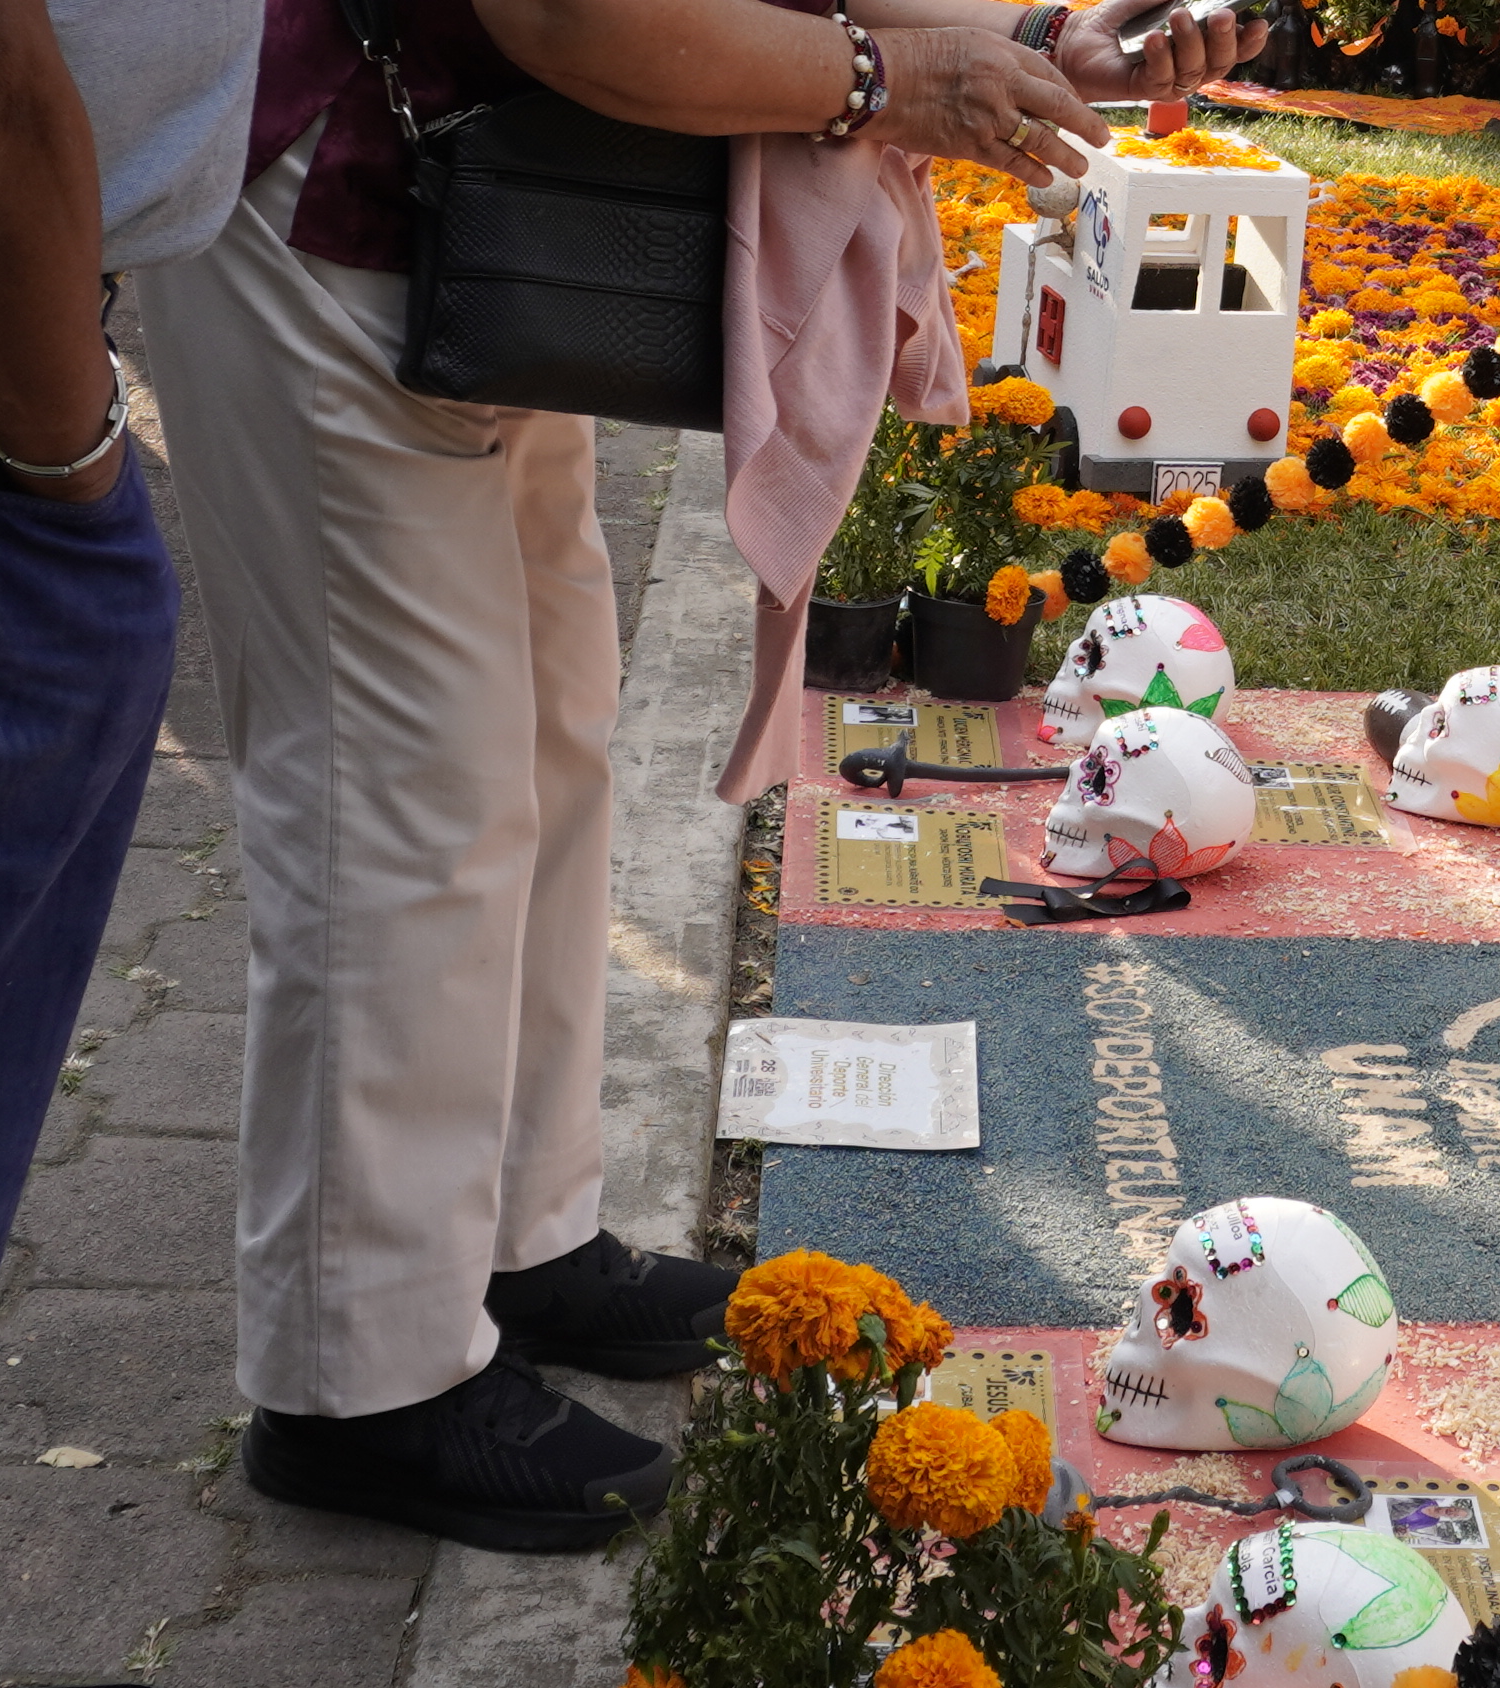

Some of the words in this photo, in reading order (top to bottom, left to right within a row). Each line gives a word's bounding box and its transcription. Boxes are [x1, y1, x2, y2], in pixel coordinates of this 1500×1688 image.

[1086, 264, 1109, 292] SALUD
[1160, 470, 1219, 501] 2025
[954, 822, 973, 864] NOBUYOSHI
[958, 865, 976, 895] MURATA
[807, 1049, 829, 1109] Universitario
[827, 1060, 851, 1097] Deporte
[855, 1056, 874, 1091] General
[877, 1062, 897, 1106] Dirección
[854, 1093, 874, 1107] del
[1319, 1043, 1450, 1188] UNAM
[1225, 1211, 1244, 1241] Ulloa
[985, 1377, 1014, 1413] JESÚS
[1255, 1545, 1287, 1596] García
